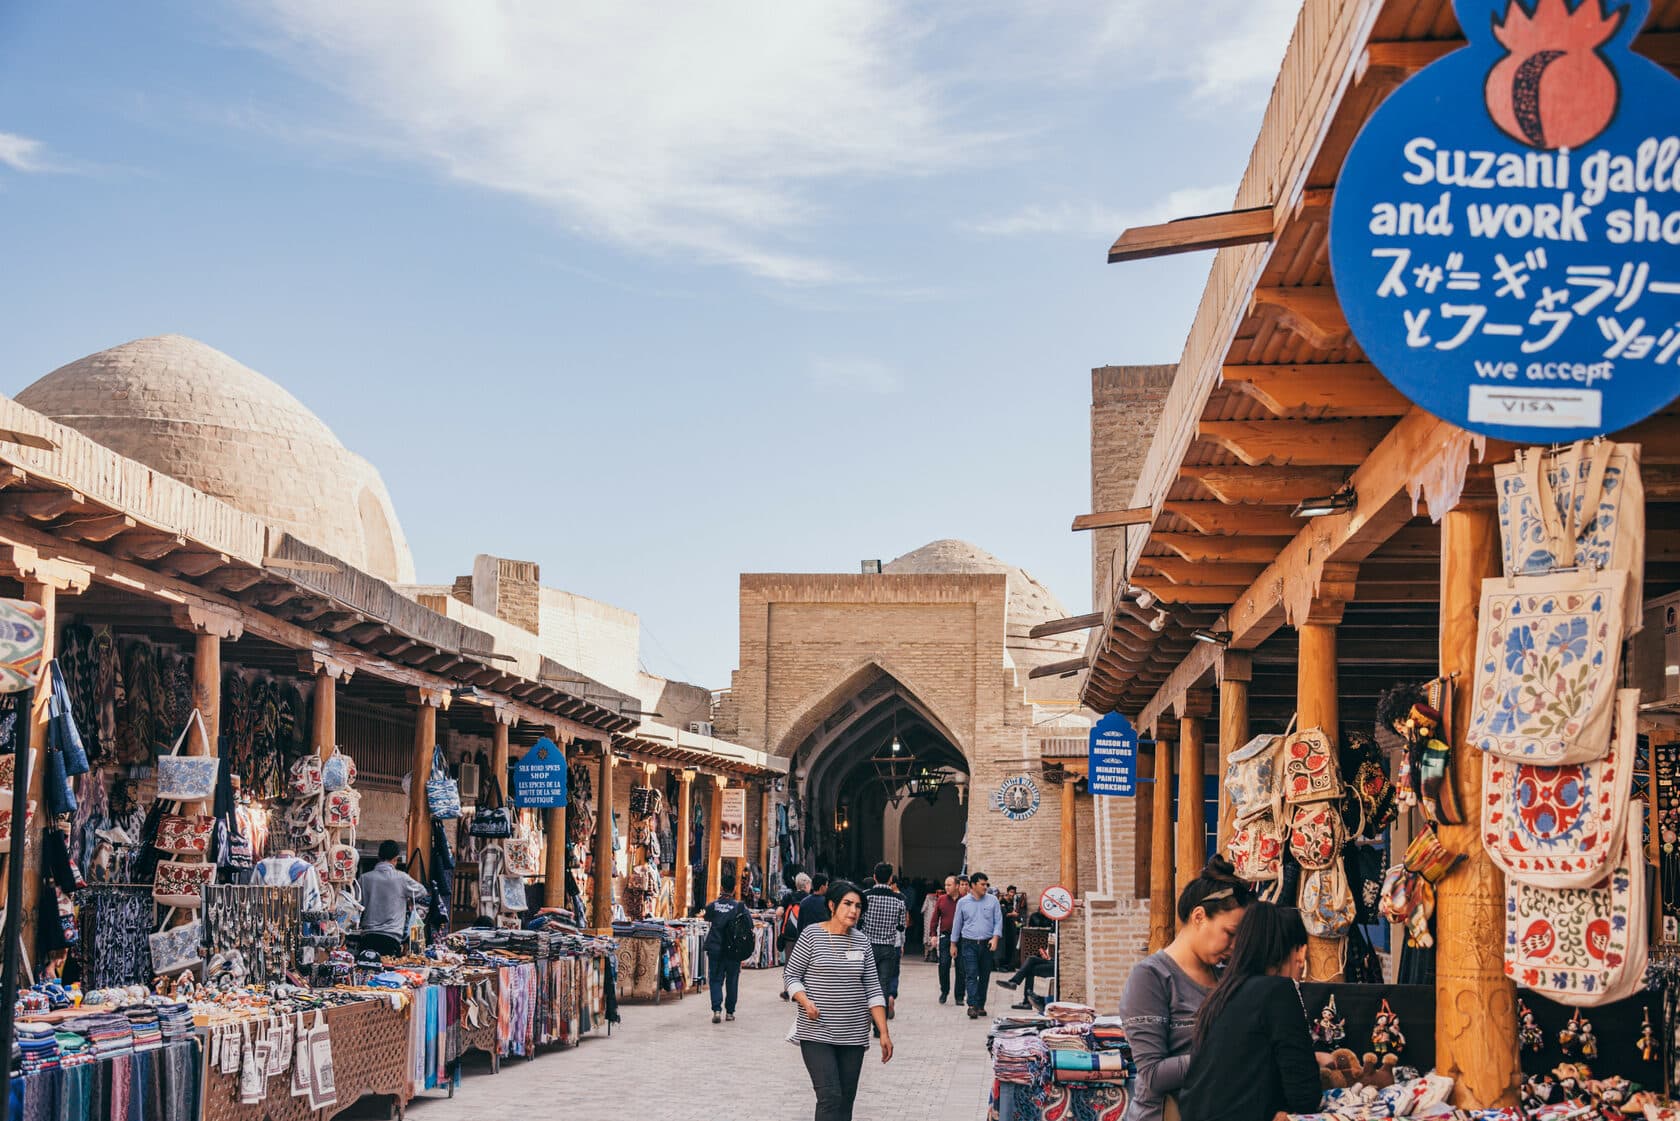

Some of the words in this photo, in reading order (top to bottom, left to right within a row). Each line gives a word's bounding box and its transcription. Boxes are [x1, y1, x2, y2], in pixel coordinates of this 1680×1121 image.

[1402, 137, 1569, 189] Suzani
[1369, 191, 1453, 236] and
[1474, 360, 1519, 380] we
[1526, 360, 1615, 387] accept
[1502, 400, 1555, 412] VISA
[1096, 739, 1121, 747] MAISON
[1122, 740, 1130, 748] DE
[1094, 747, 1132, 756] MINIATURES
[519, 764, 529, 772] SILK
[1097, 775, 1128, 783] PAINTING
[1093, 782, 1131, 792] WORKSHOP
